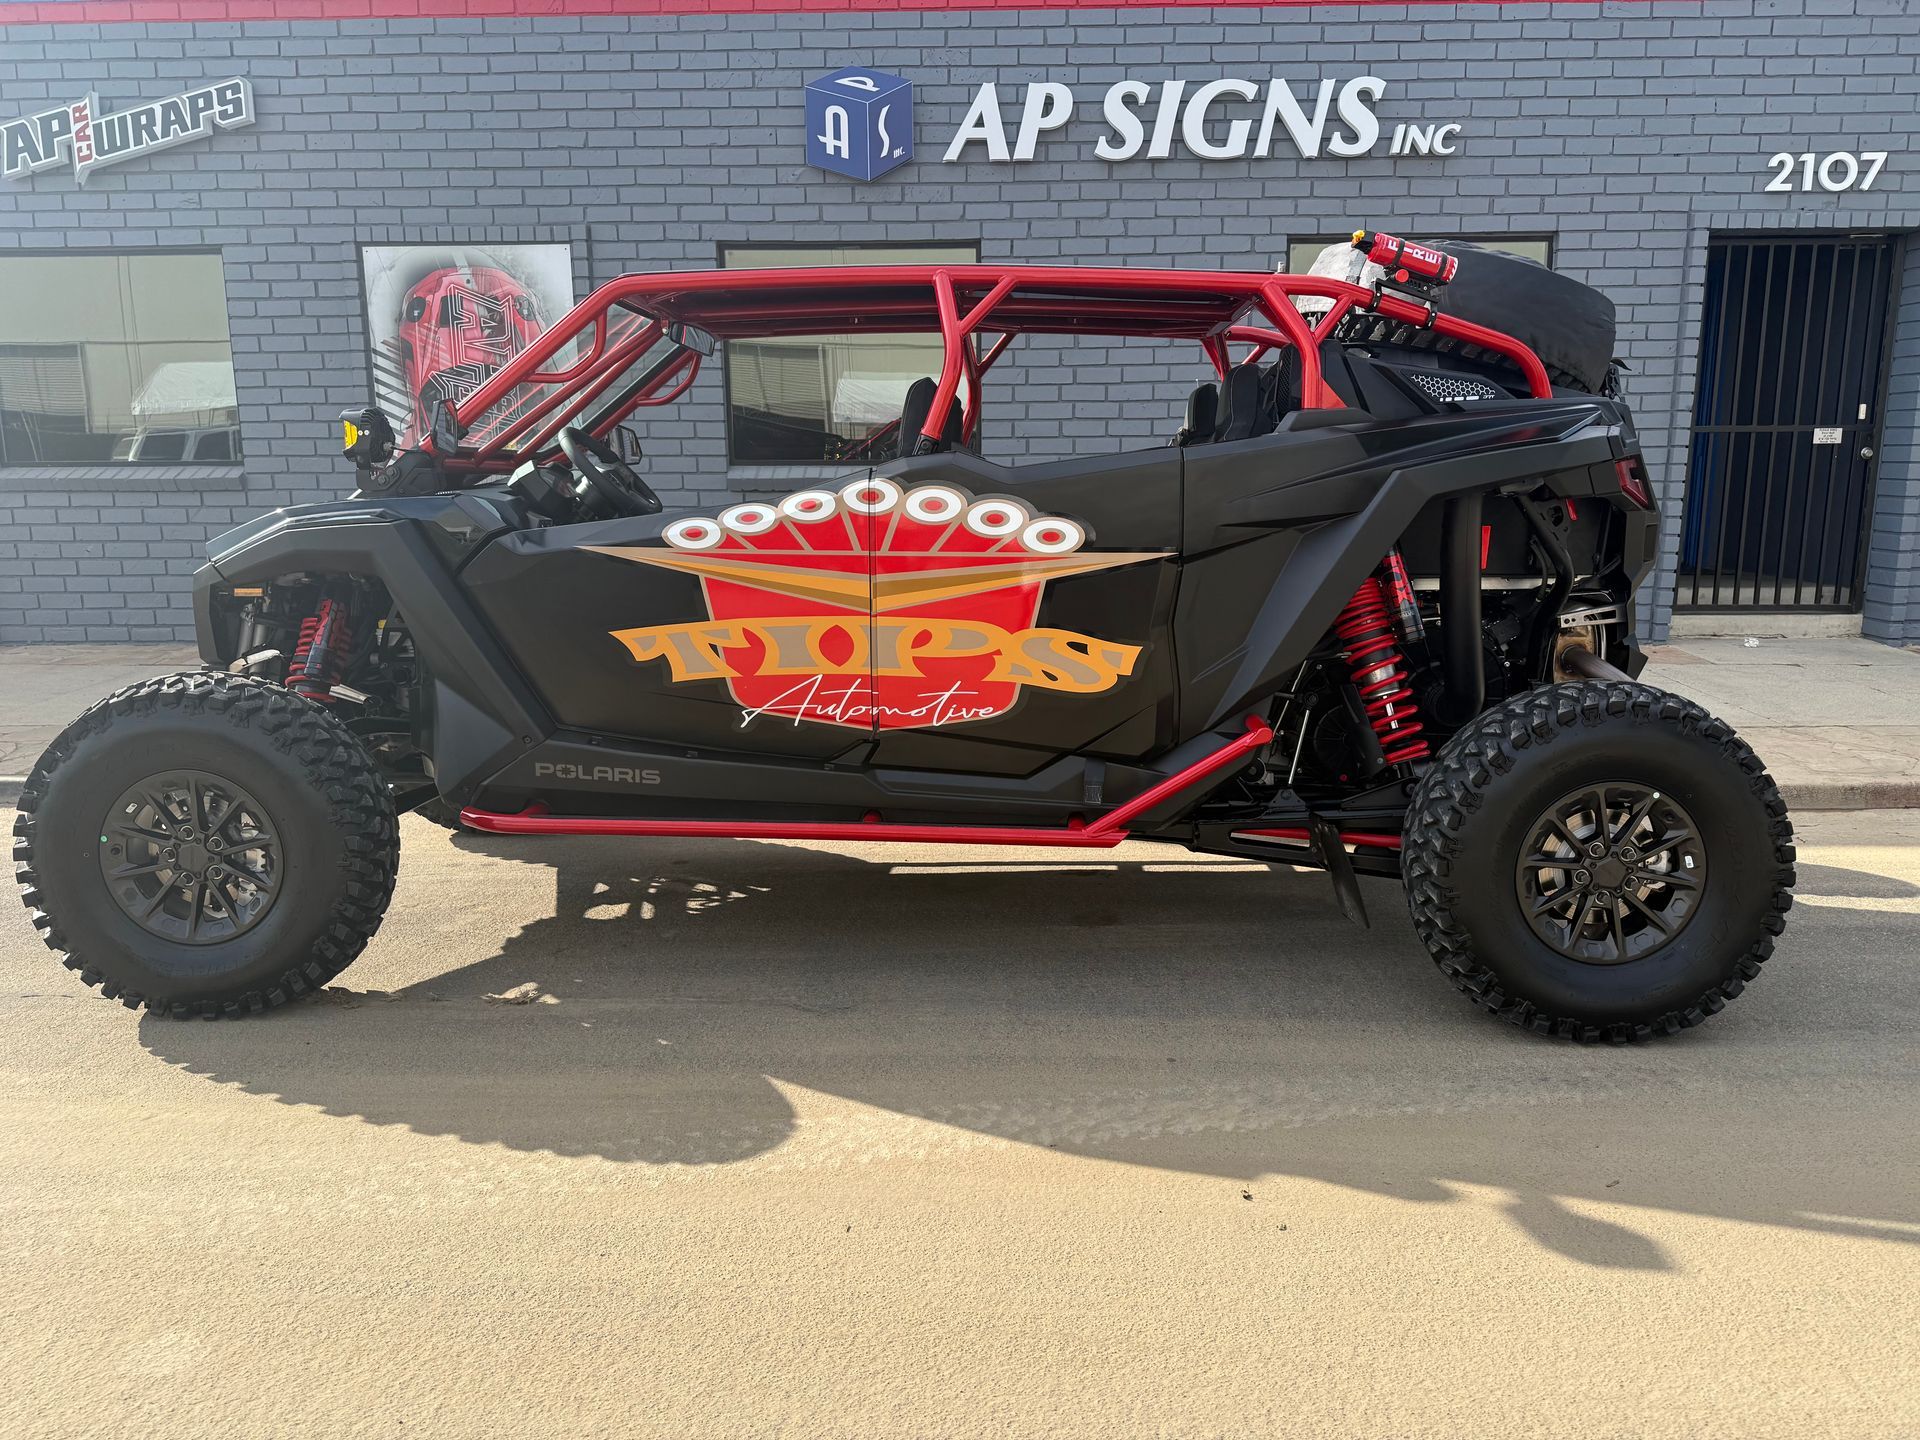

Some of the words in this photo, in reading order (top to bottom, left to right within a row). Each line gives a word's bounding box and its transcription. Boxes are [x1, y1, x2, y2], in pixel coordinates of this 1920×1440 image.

[2, 108, 71, 173] AP
[72, 102, 95, 166] CAR
[93, 80, 245, 158] WRAPS
[942, 81, 1074, 163] AP
[1094, 75, 1387, 162] SIGNS
[1388, 122, 1462, 157] INC
[1764, 151, 1888, 192] 2107
[608, 615, 1143, 693] TOPS
[741, 674, 1002, 729] Automotive
[535, 762, 662, 785] POLARIS
